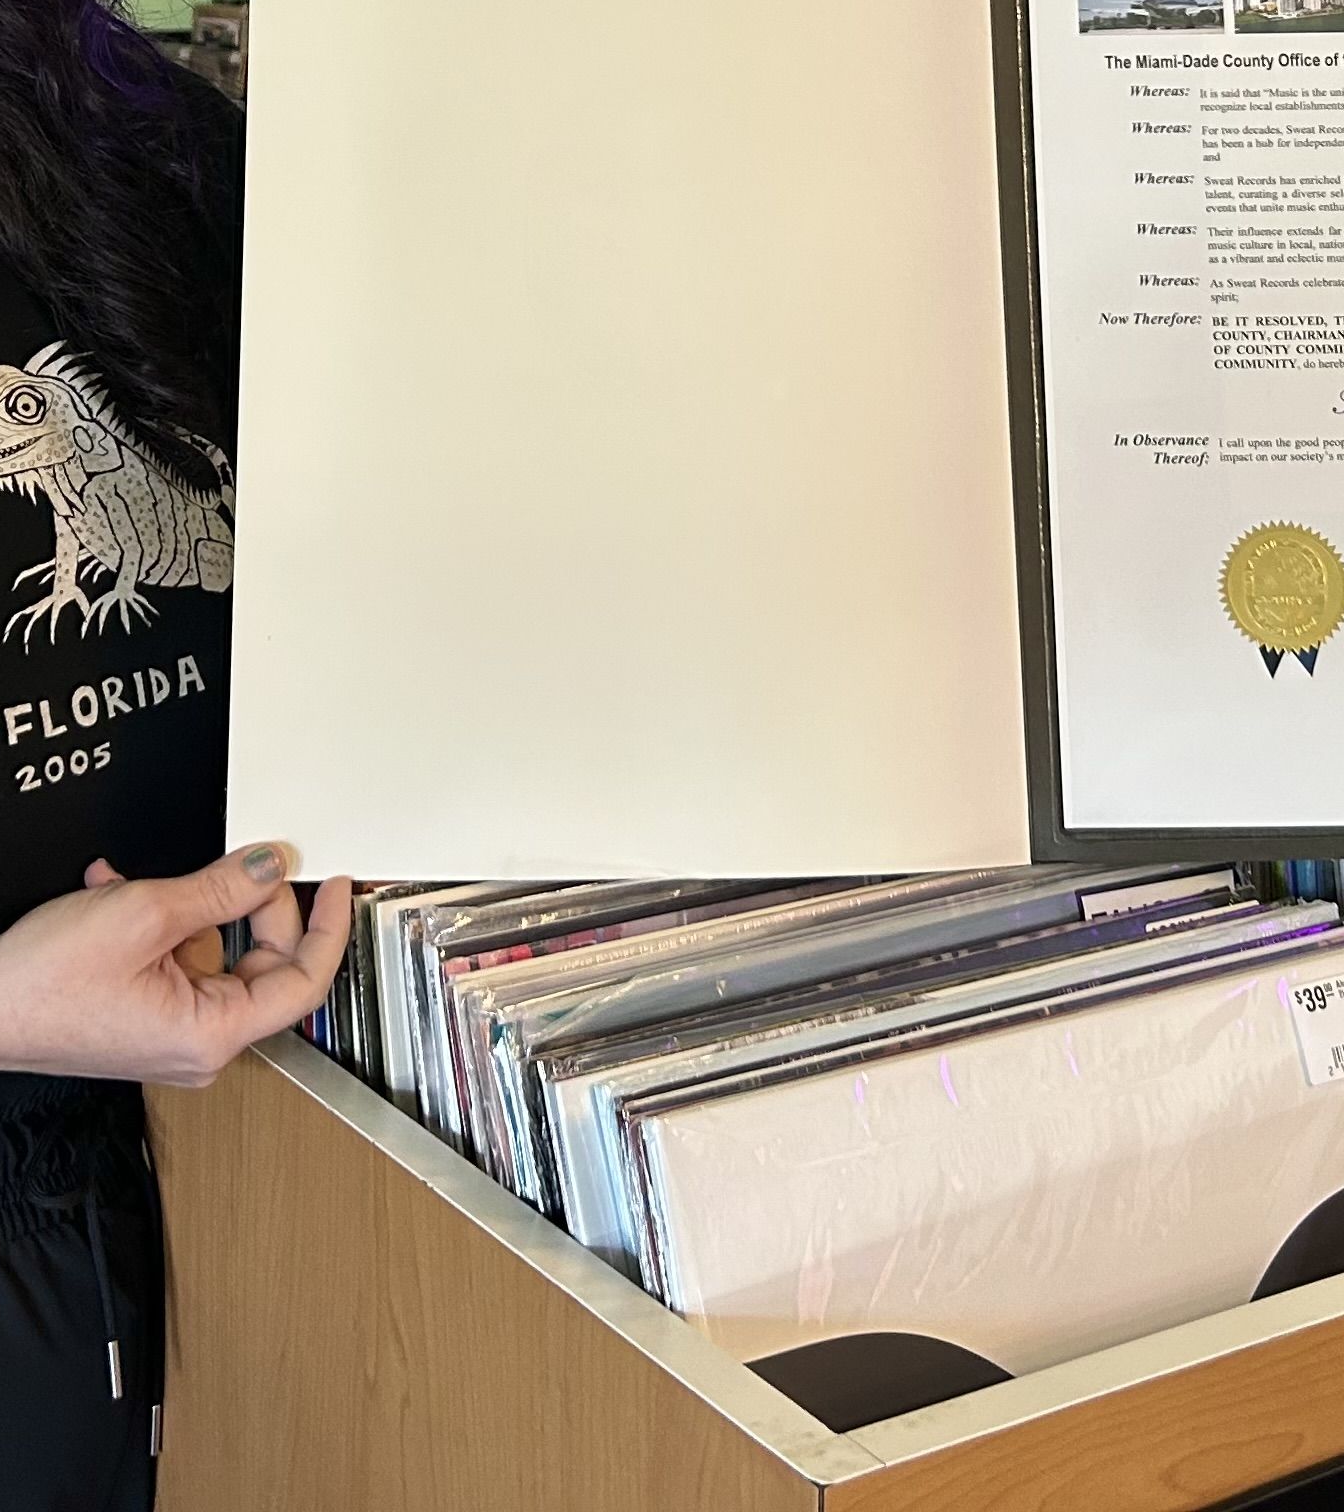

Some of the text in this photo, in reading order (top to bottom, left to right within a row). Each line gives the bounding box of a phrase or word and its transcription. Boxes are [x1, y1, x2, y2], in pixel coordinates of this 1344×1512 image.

[1104, 55, 1132, 70] The
[1135, 53, 1219, 69] Miami-Dade
[1222, 53, 1274, 71] County
[1278, 52, 1321, 67] Office
[1324, 52, 1339, 67] of
[1130, 85, 1191, 97] Whereas:
[1131, 121, 1192, 134] Whereas:
[1134, 172, 1195, 185] Whereas:
[1137, 223, 1197, 235] Whereas:
[1139, 274, 1200, 287] Whereas:
[1098, 312, 1202, 328] Now Therefore:
[1211, 316, 1229, 327] BE
[1235, 316, 1250, 327] IT
[1255, 315, 1328, 328] RESOLVED,
[1212, 330, 1272, 343] COUNTY,
[1213, 344, 1232, 355] OF
[1236, 344, 1291, 356] COUNTY
[1214, 358, 1302, 370] COMMUNITY,
[1114, 433, 1210, 447] In Observance
[1153, 451, 1210, 468] Thereof:
[4, 654, 206, 745] FLORIDA
[15, 741, 113, 792] 2005
